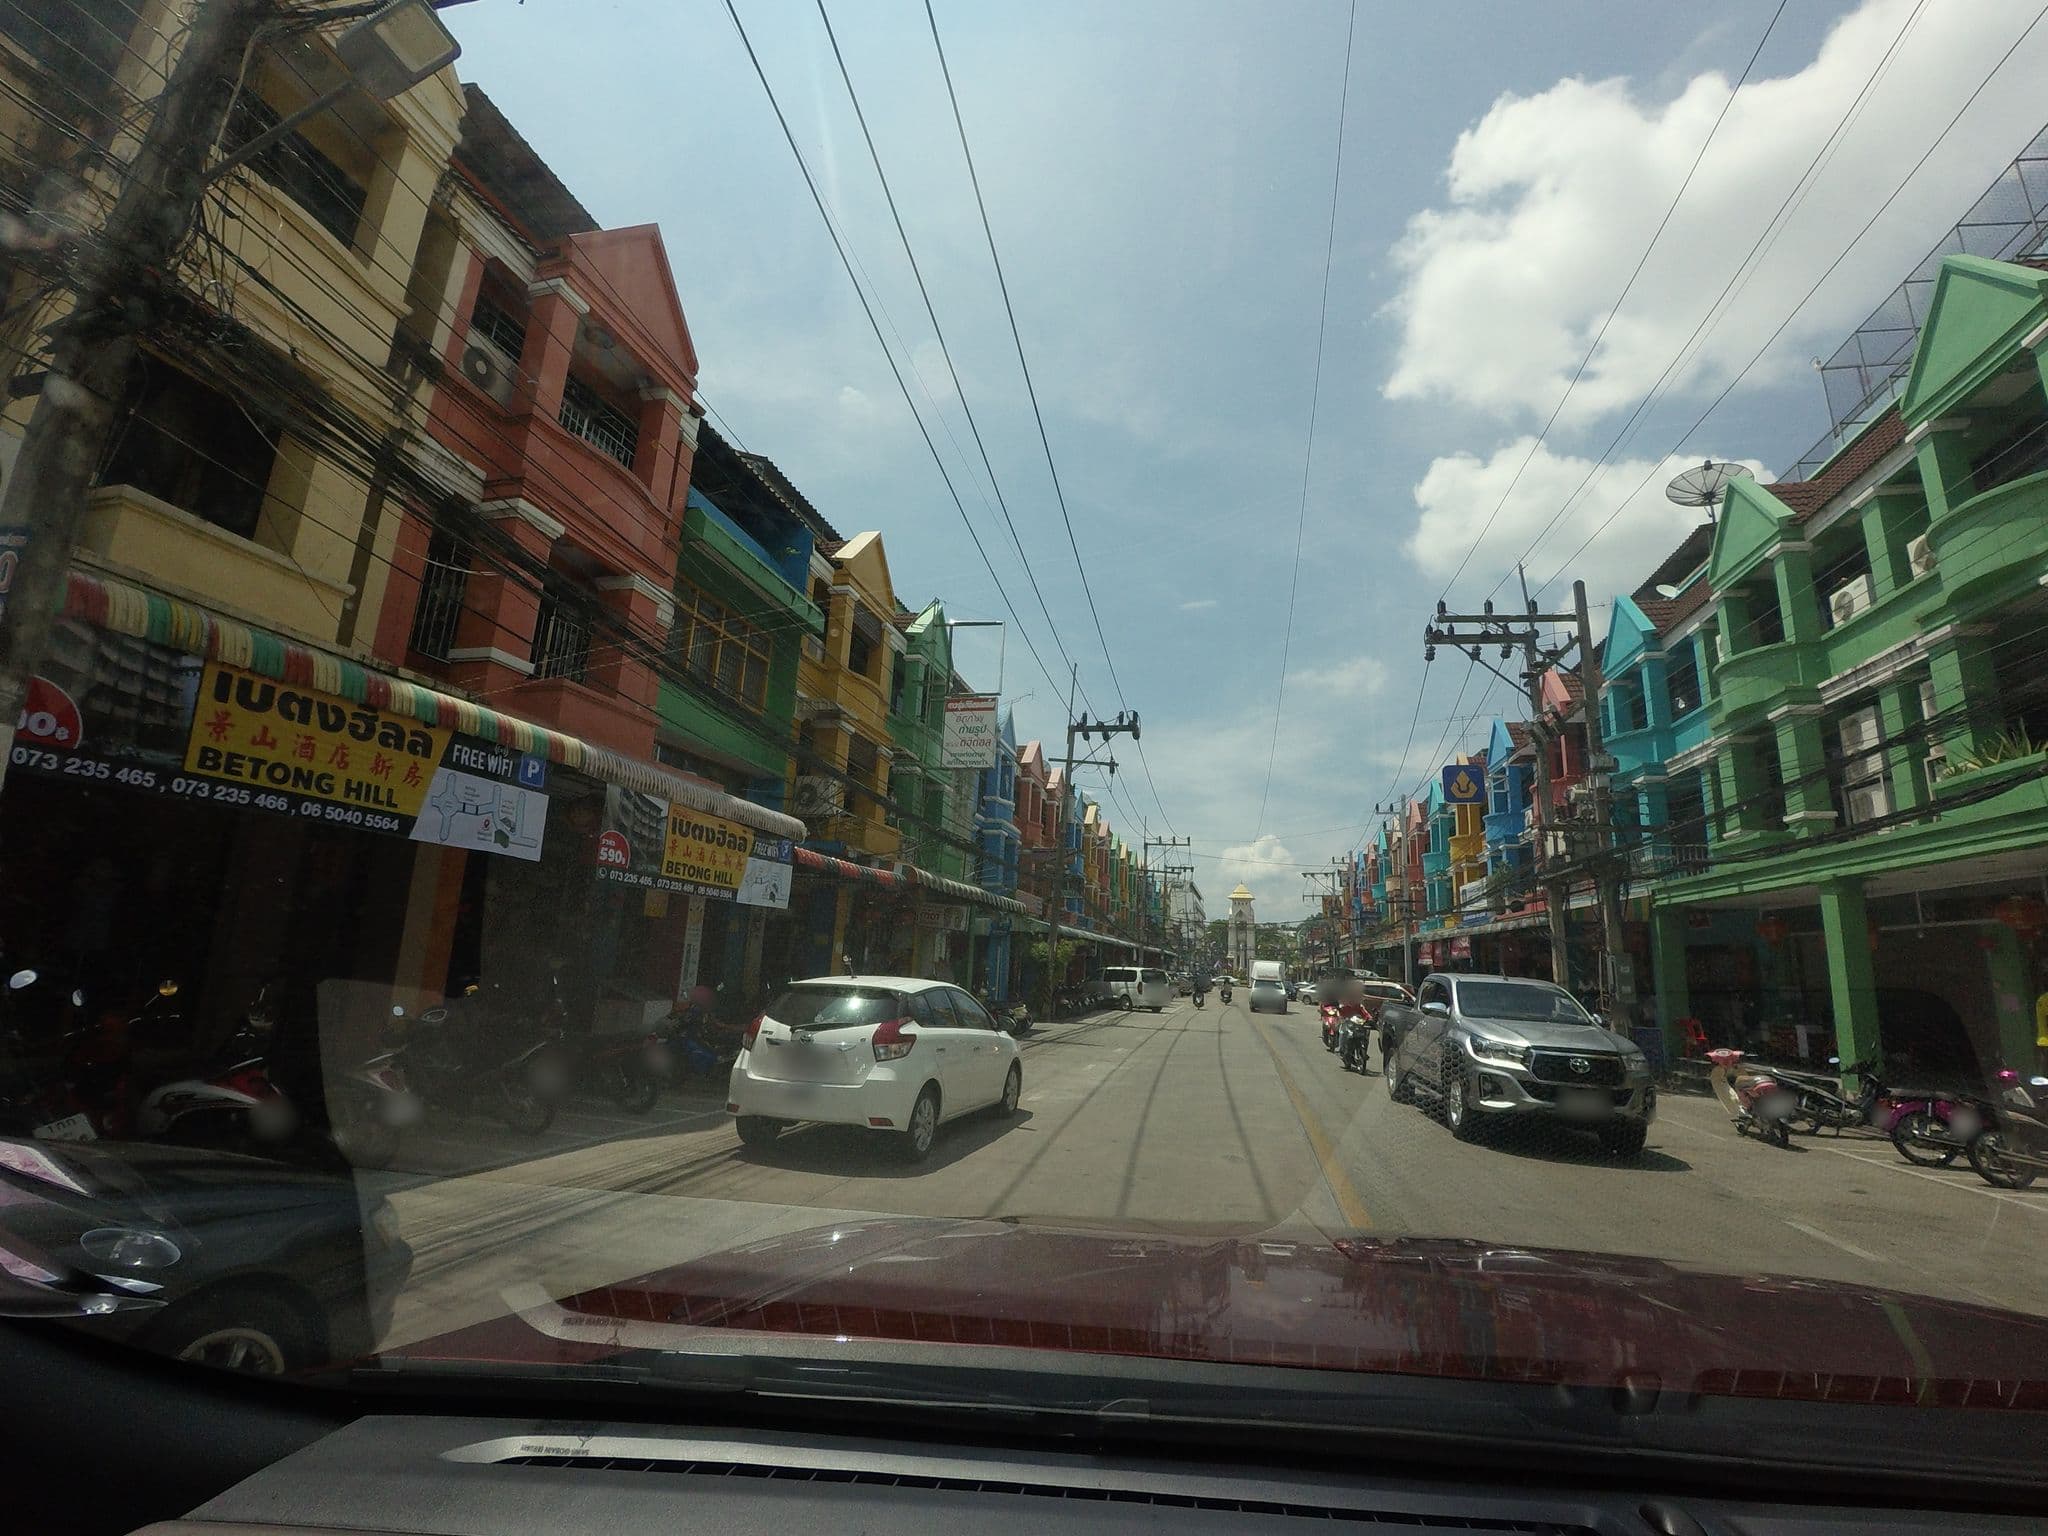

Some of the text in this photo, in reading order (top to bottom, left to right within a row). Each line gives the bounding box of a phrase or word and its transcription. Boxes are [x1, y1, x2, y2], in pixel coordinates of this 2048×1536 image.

[214, 671, 434, 759] เบตงฮิลล์
[11, 746, 58, 770] 073
[63, 758, 110, 779] 235
[171, 777, 209, 798] 073
[213, 785, 250, 805] 235
[300, 801, 322, 817] 06
[324, 807, 362, 825] 5040
[364, 813, 399, 831] 5564
[197, 746, 399, 808] BETONG HILL
[671, 817, 748, 853] เบตงฮิลล์
[609, 870, 623, 881] 073
[623, 873, 638, 884] 235
[665, 860, 733, 885] BETONG HILL
